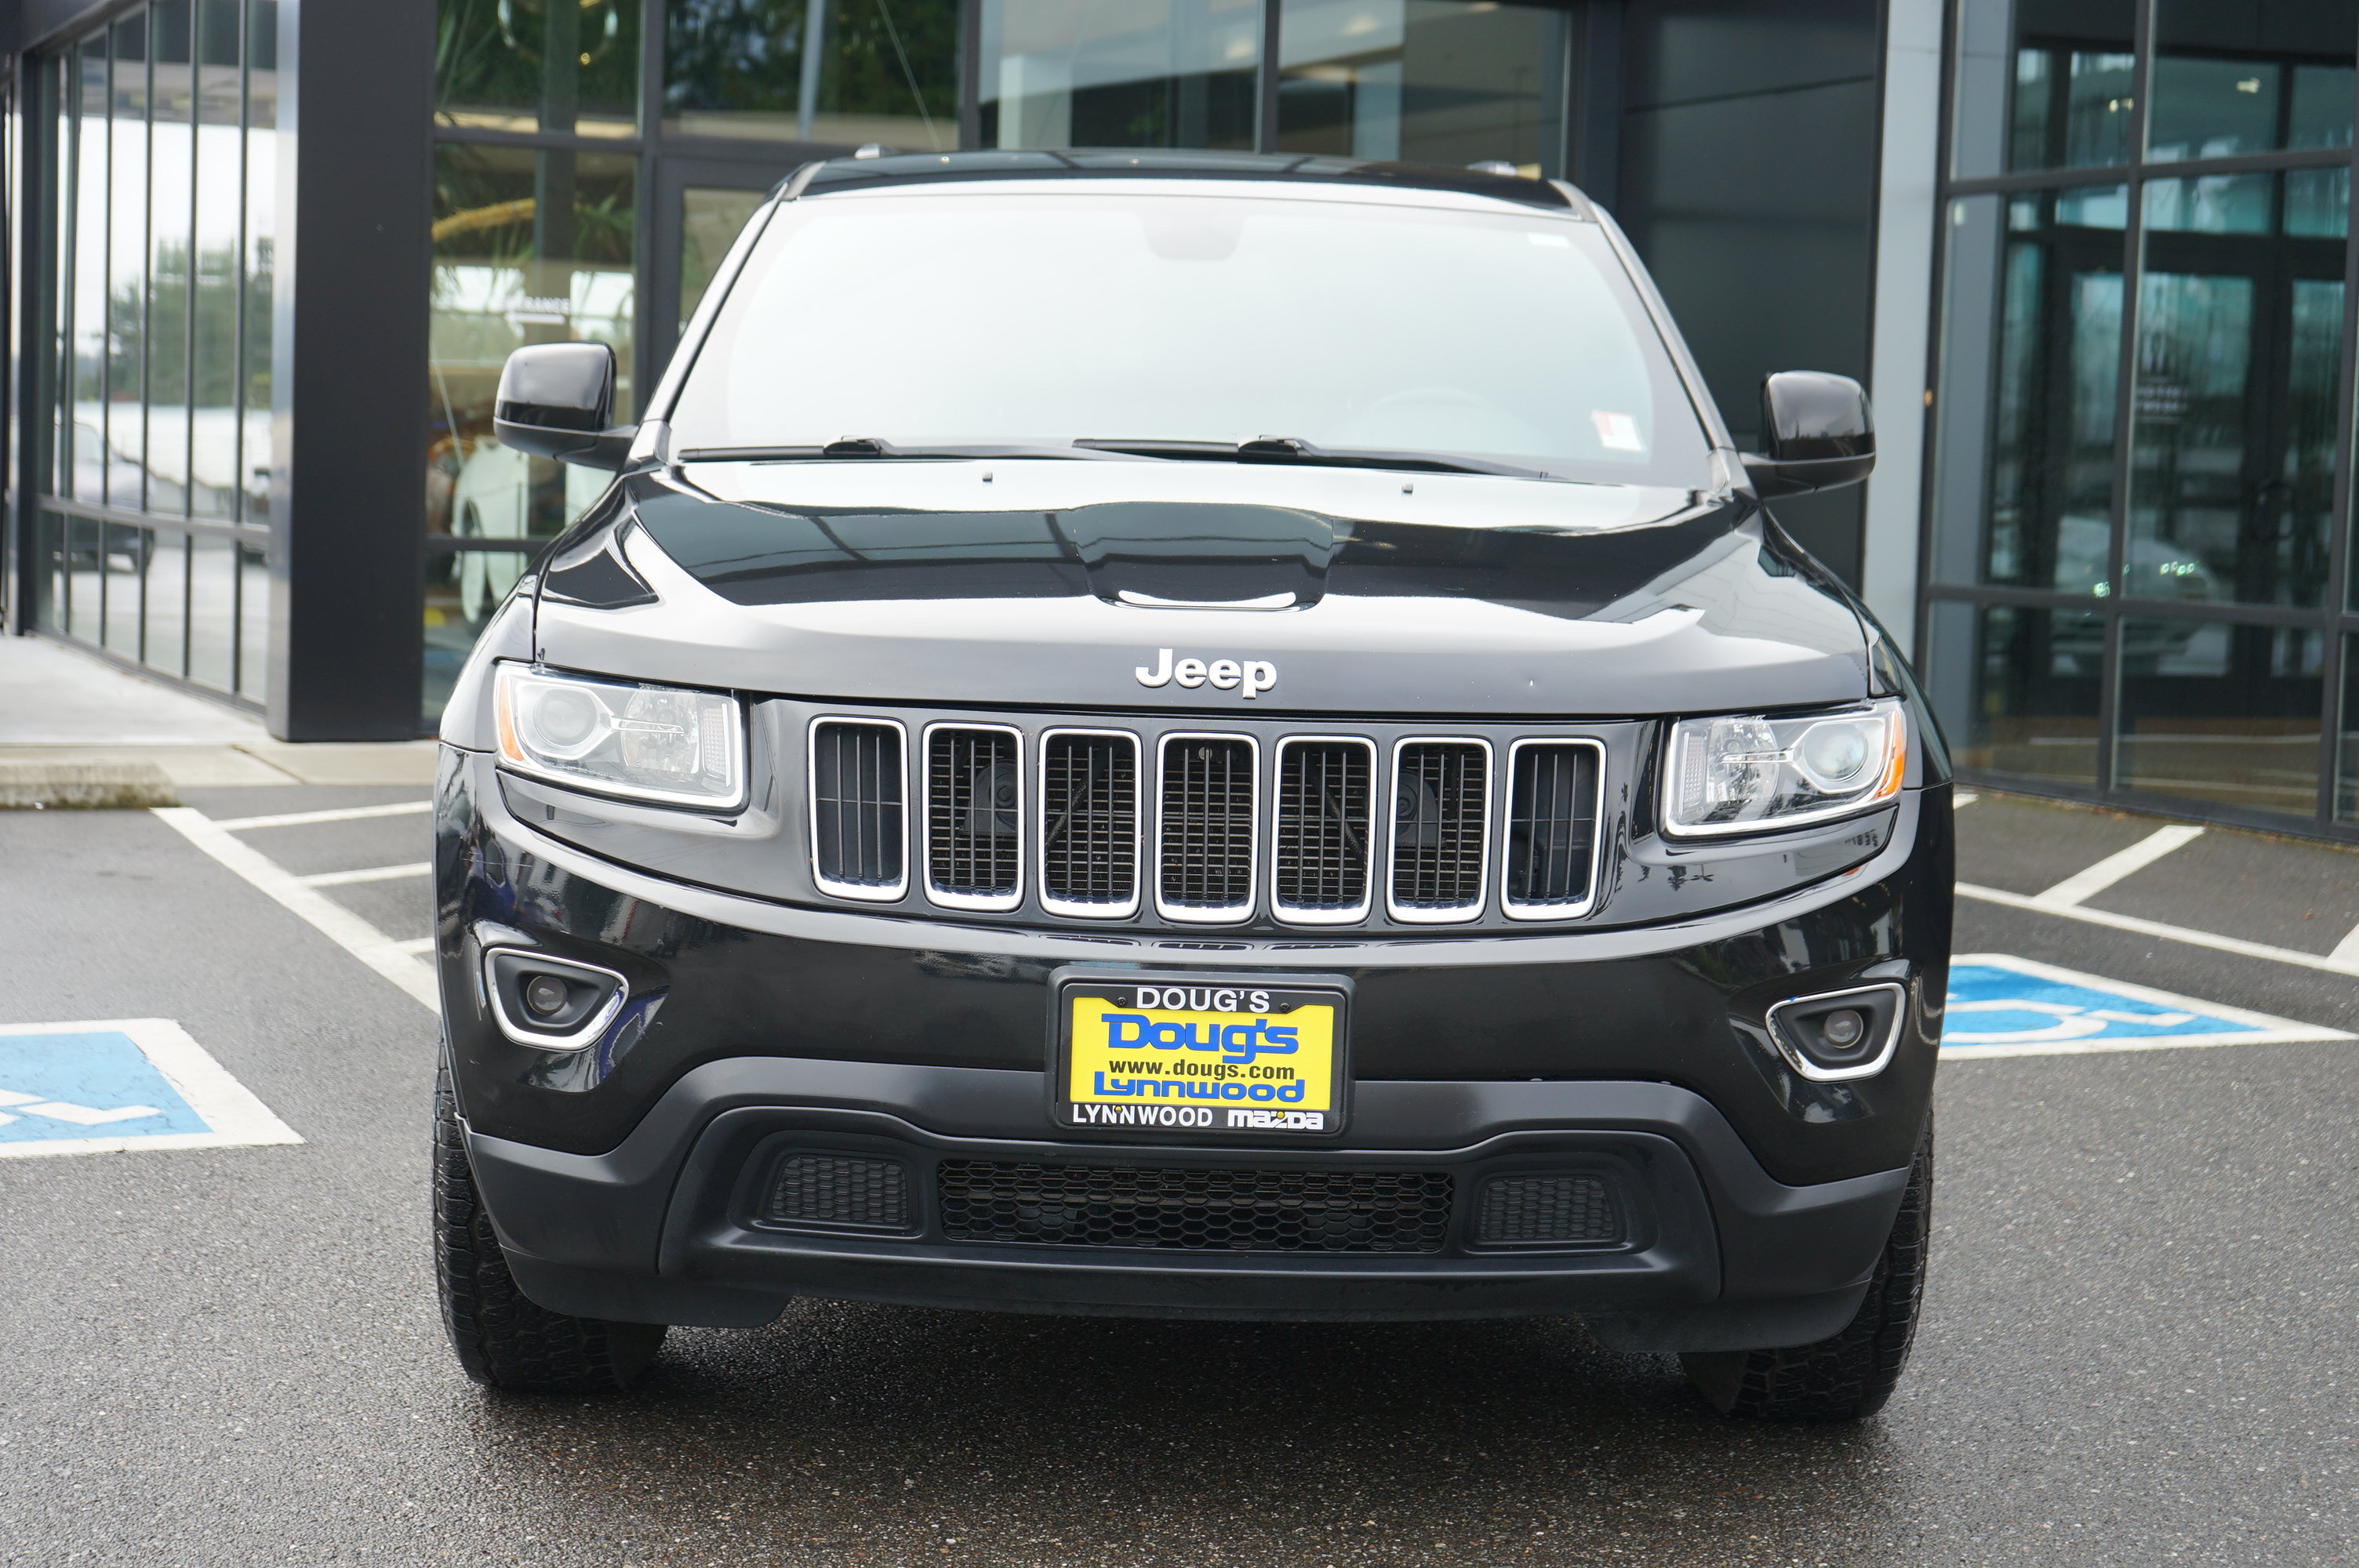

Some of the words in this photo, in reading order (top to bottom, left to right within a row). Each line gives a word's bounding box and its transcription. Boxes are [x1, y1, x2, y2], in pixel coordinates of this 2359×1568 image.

[1136, 648, 1278, 699] Jeep
[1136, 987, 1270, 1014] DOUG'S
[1101, 1014, 1299, 1064] Doug's
[1109, 1058, 1295, 1081] www.dougs.com
[1094, 1071, 1305, 1102] Lynnwood
[1073, 1103, 1213, 1127] LYNNWOOD
